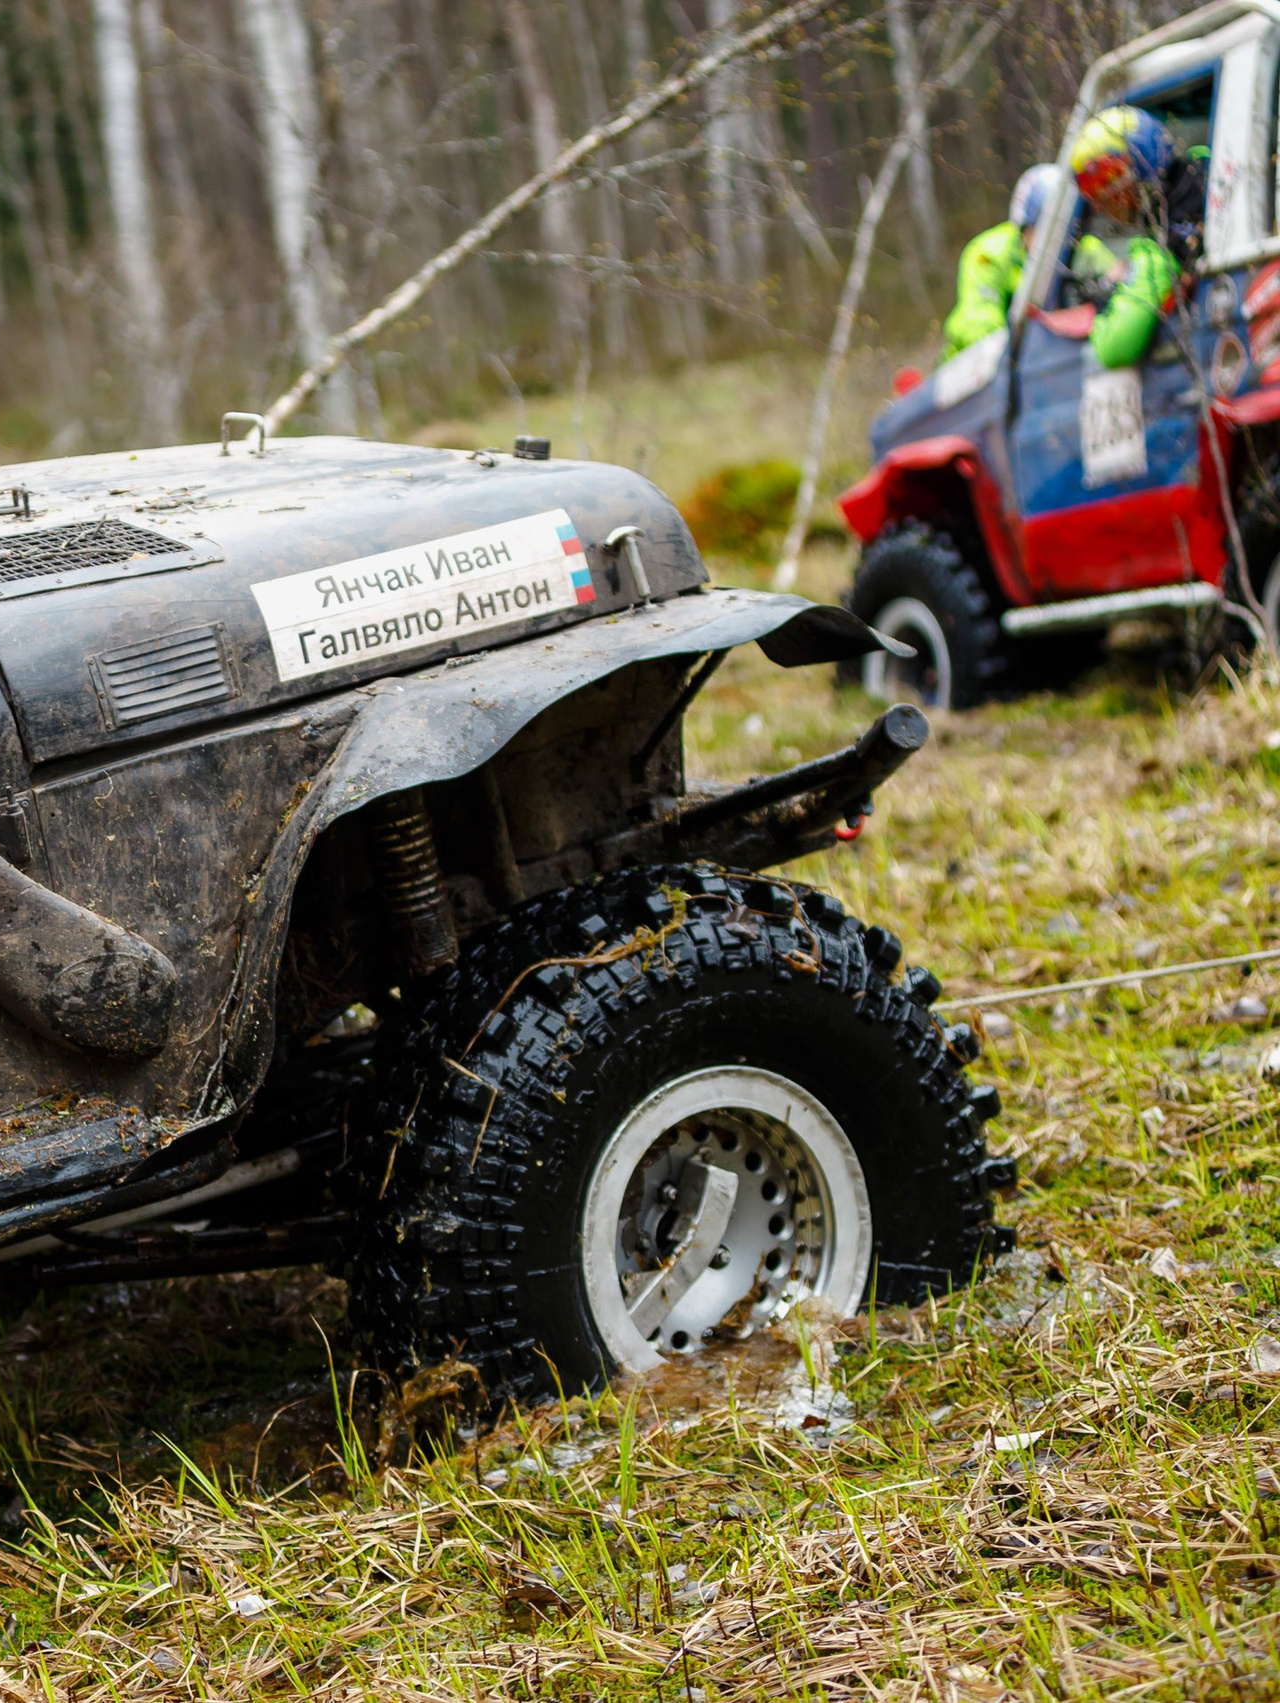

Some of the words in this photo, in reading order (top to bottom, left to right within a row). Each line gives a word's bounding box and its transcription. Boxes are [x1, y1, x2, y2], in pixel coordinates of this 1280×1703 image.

[313, 562, 423, 609] Янчак
[424, 540, 513, 580] Иван
[298, 606, 443, 665] Галвяло
[455, 578, 552, 625] Антон
